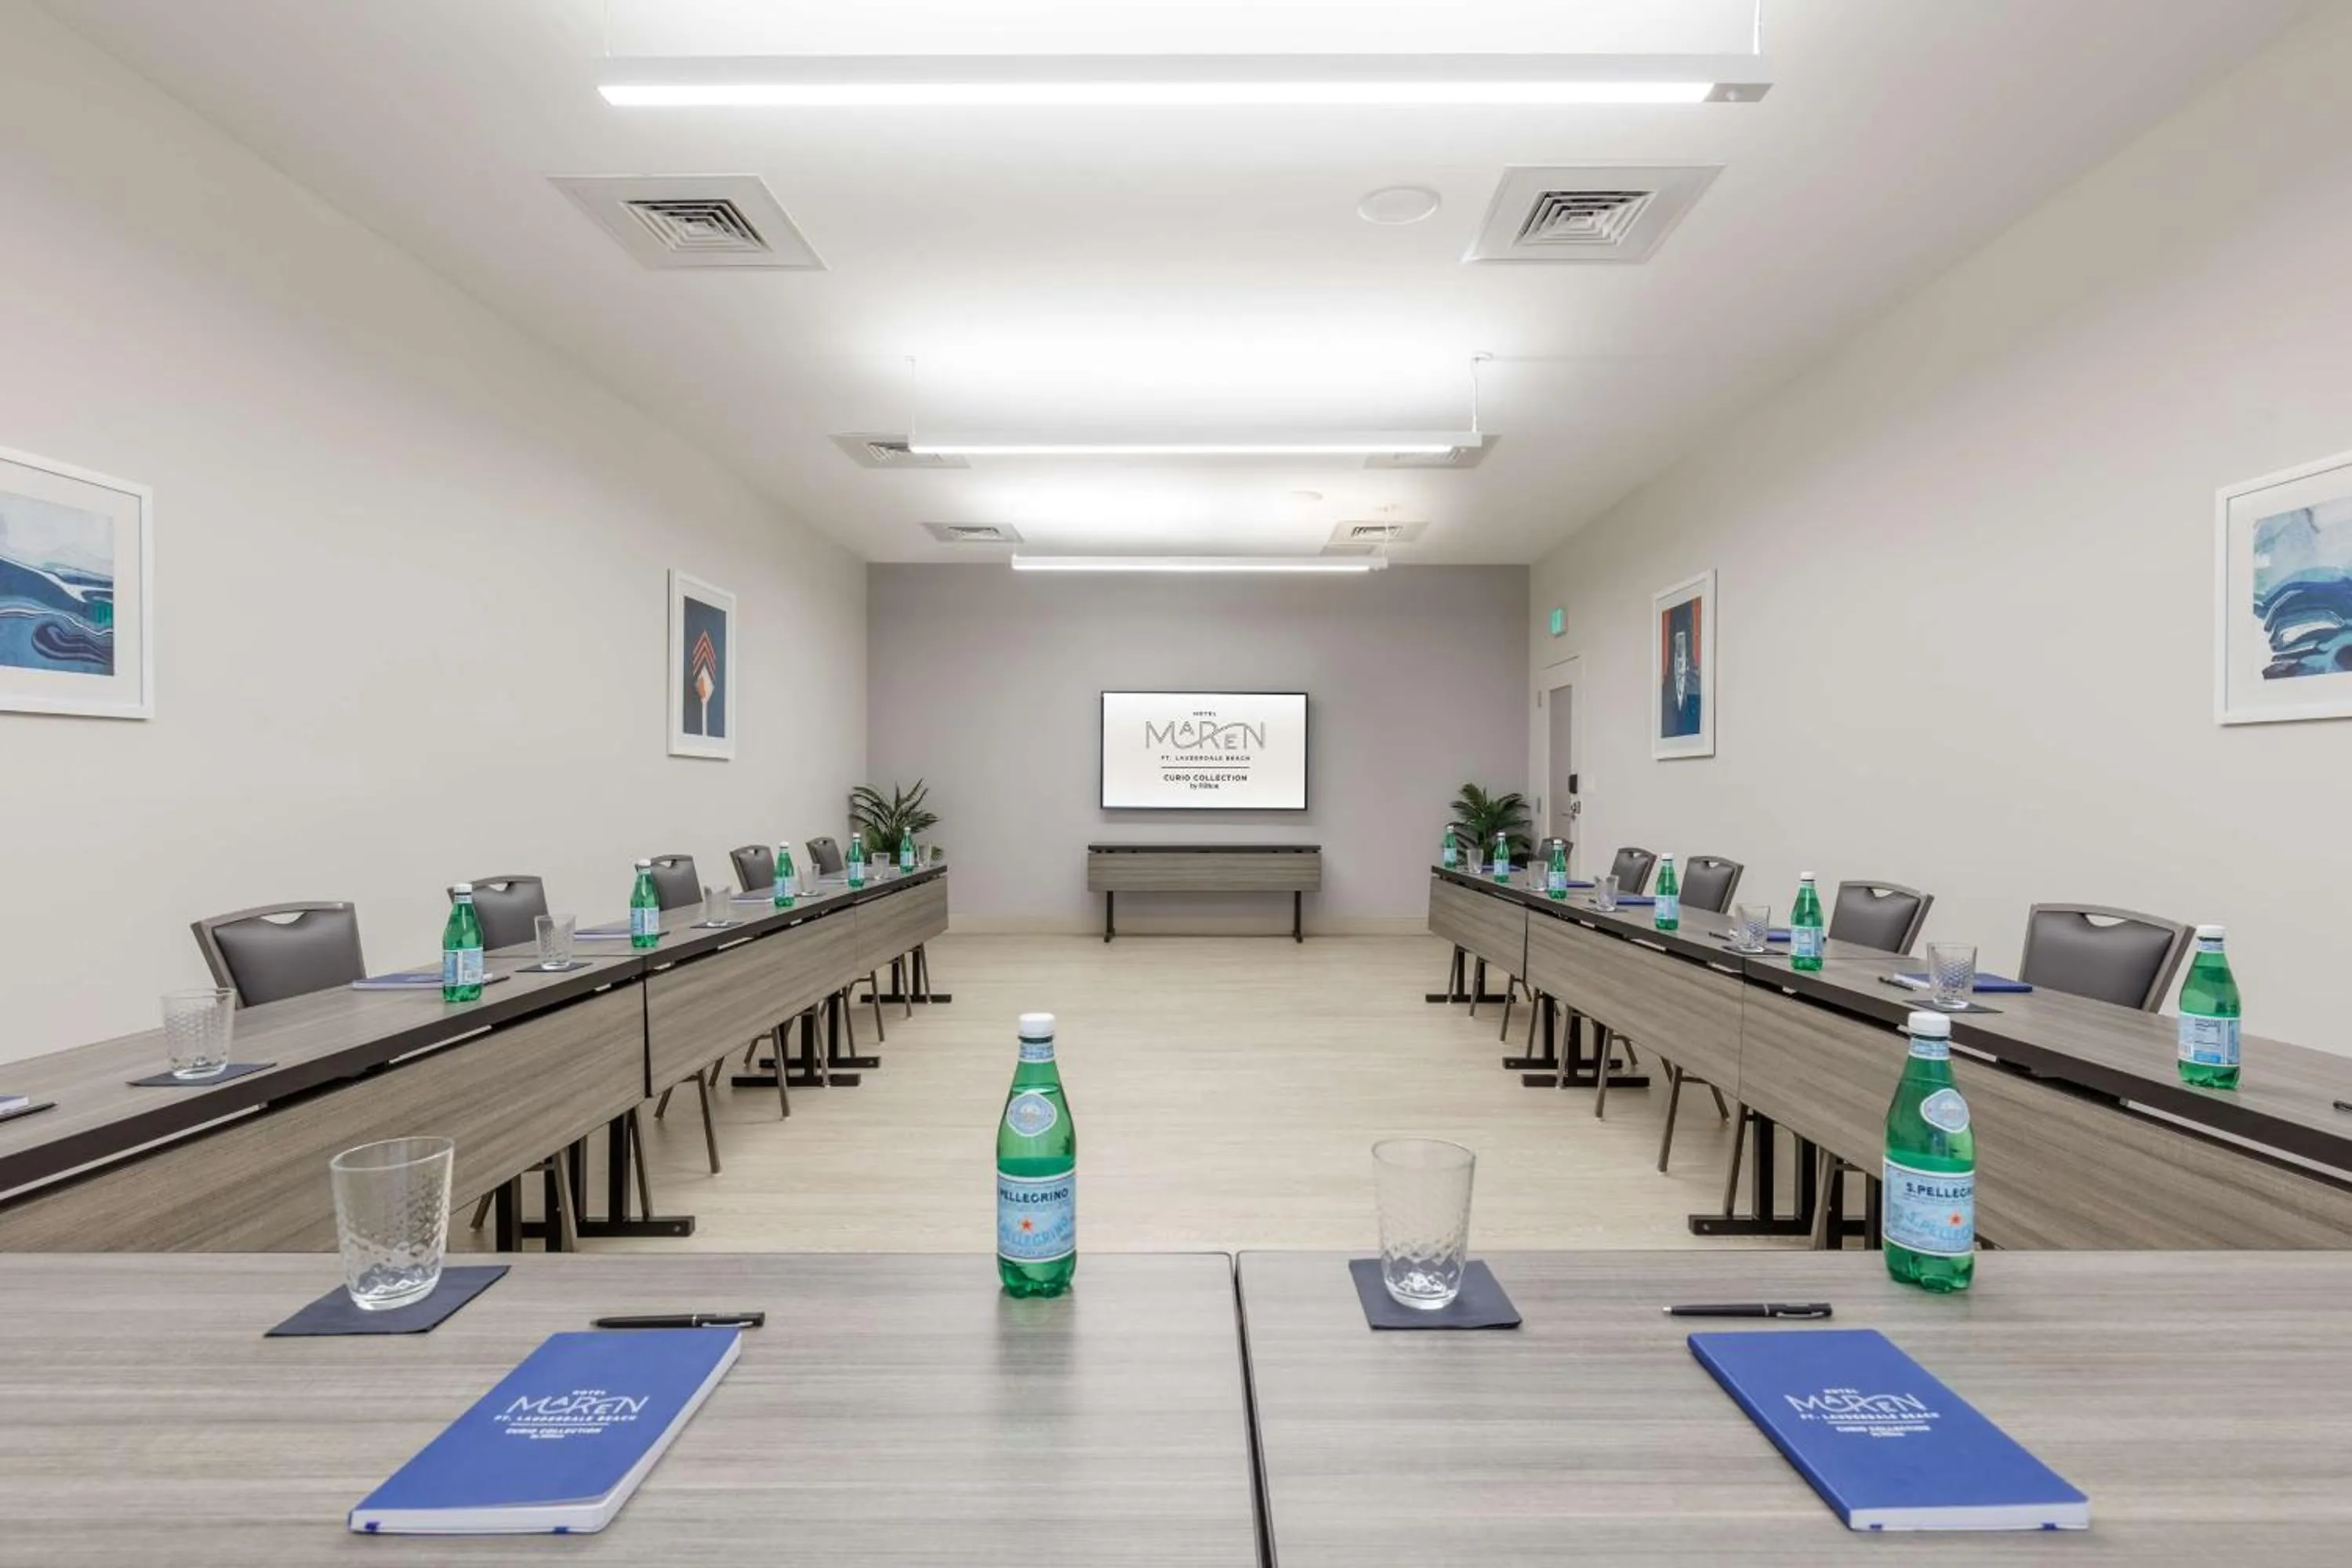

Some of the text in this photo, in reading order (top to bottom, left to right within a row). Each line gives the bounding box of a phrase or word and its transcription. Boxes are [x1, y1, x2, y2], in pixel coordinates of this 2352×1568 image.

[1145, 720, 1265, 749] MAREN
[1163, 774, 1248, 782] CURIO COLLECTION
[506, 1395, 650, 1414] MAREN
[1784, 1392, 1929, 1413] MAREN
